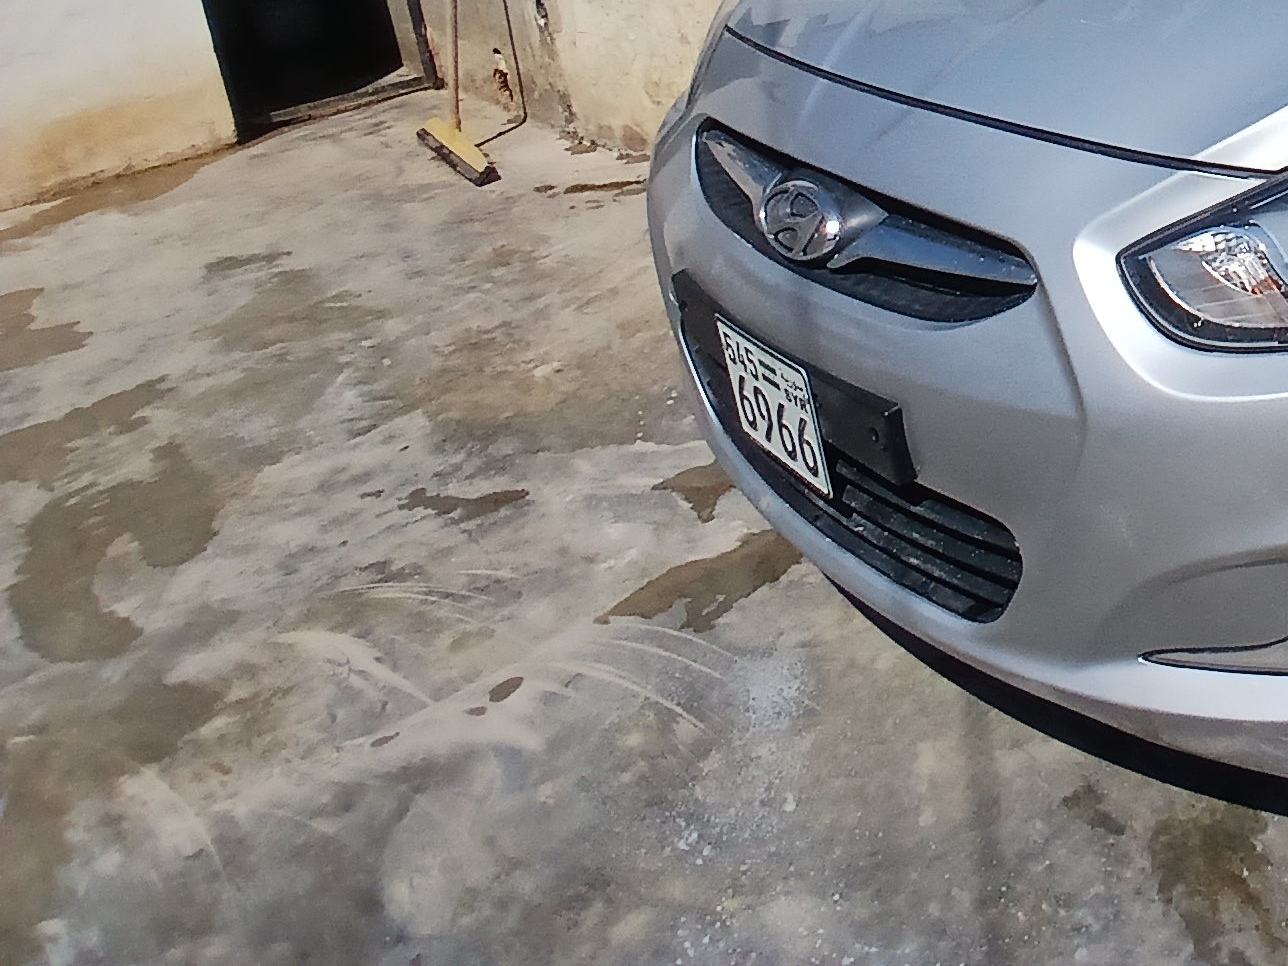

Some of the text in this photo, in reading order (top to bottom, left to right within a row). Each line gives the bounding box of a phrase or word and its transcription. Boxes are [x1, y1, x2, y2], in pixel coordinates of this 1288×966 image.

[723, 331, 759, 381] 545
[784, 388, 809, 414] SYR
[738, 374, 820, 479] 6966
